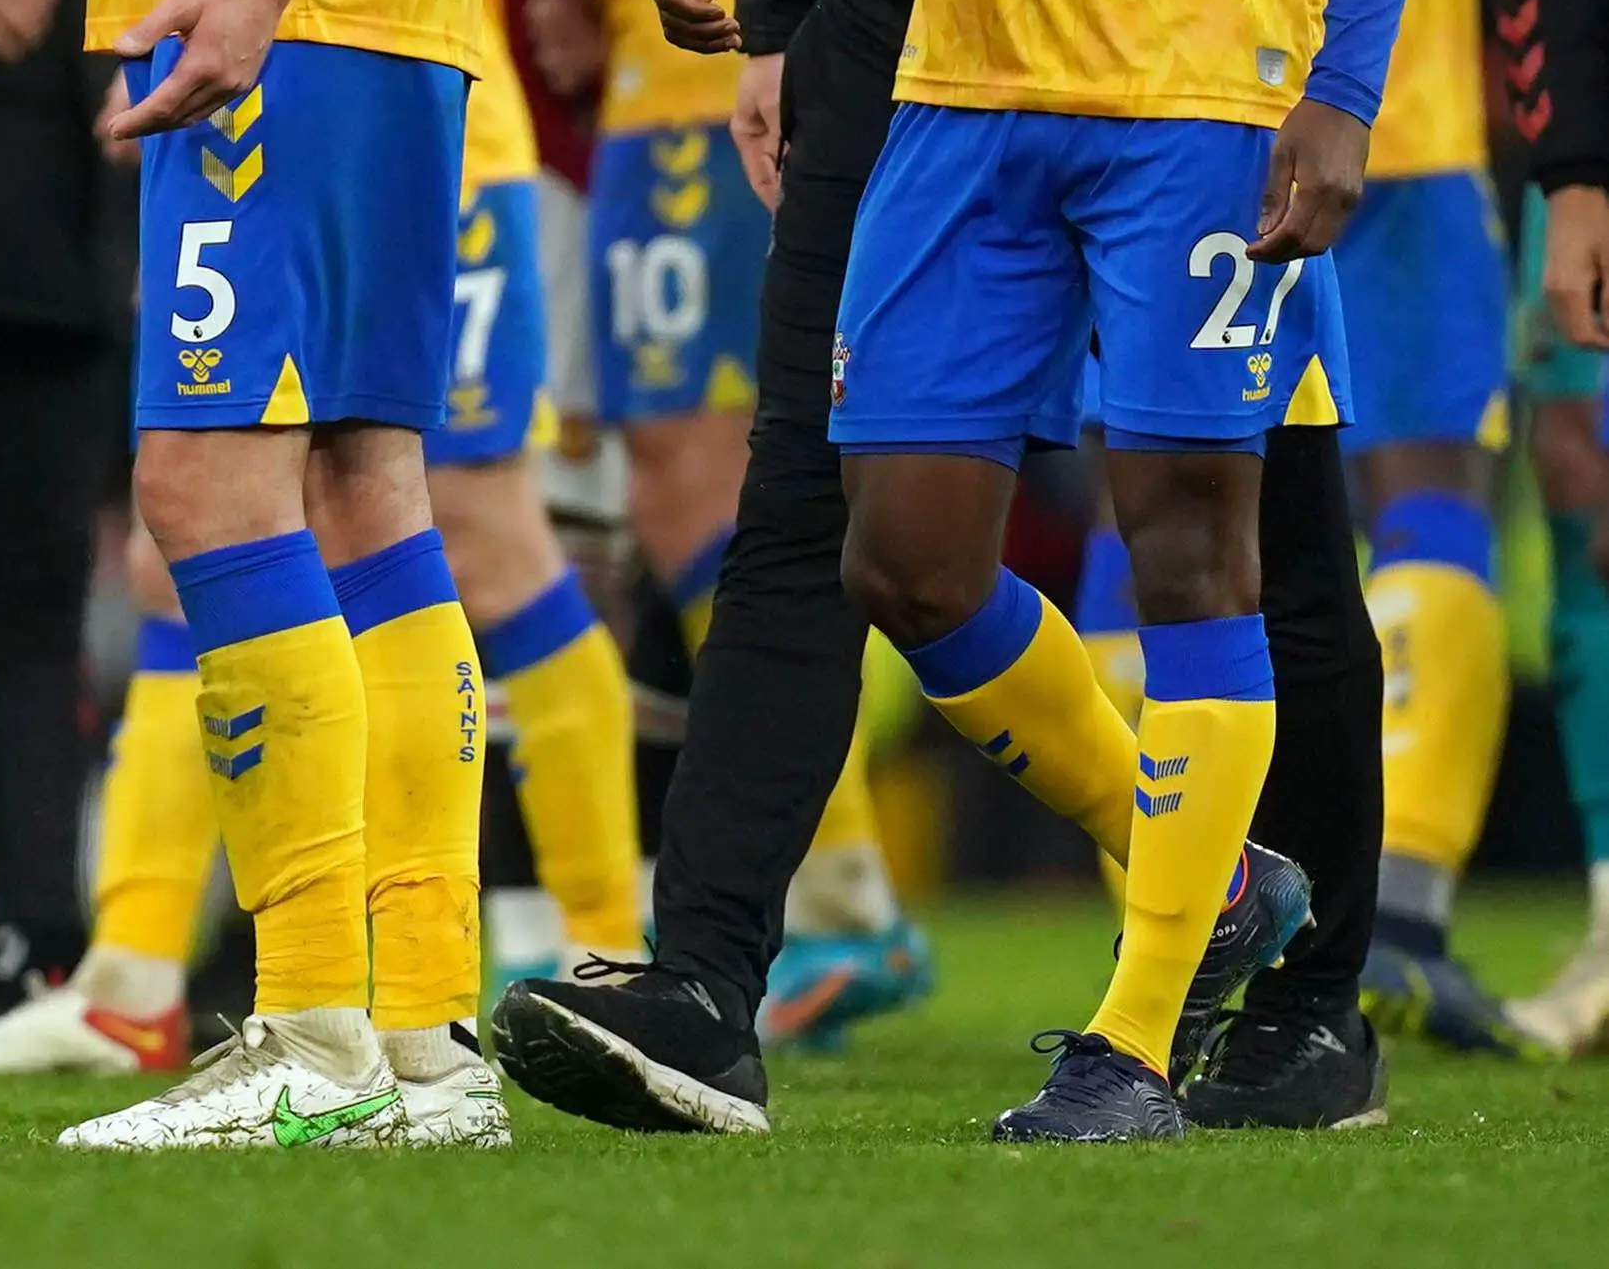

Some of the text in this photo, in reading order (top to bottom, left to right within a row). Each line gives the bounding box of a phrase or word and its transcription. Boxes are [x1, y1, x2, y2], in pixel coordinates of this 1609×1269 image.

[169, 219, 238, 345] 5
[605, 234, 709, 345] 10
[176, 378, 231, 396] hummel
[456, 661, 476, 762] SAINTS
